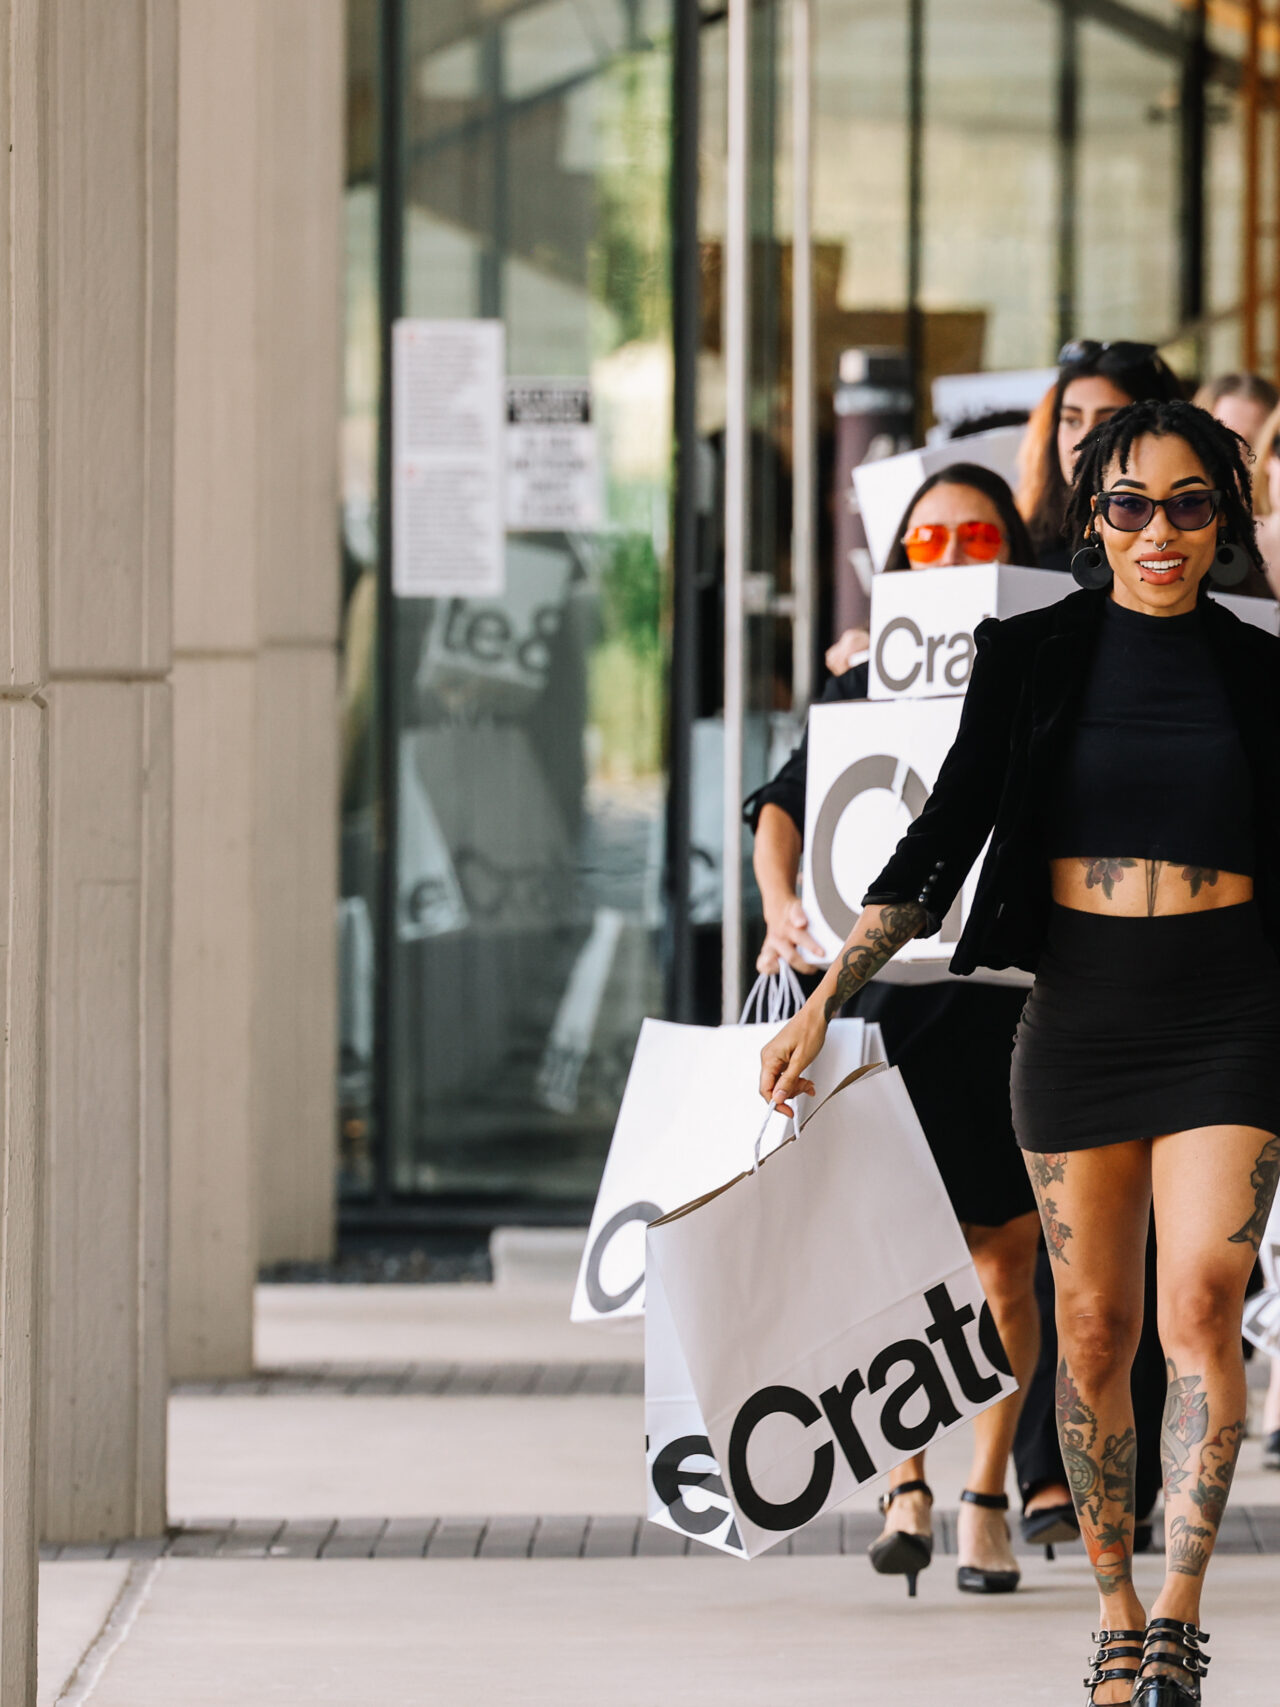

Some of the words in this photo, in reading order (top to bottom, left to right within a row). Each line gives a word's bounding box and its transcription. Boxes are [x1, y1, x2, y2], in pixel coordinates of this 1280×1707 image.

[875, 615, 991, 691] Cra
[811, 754, 963, 945] C
[585, 1201, 665, 1314] C
